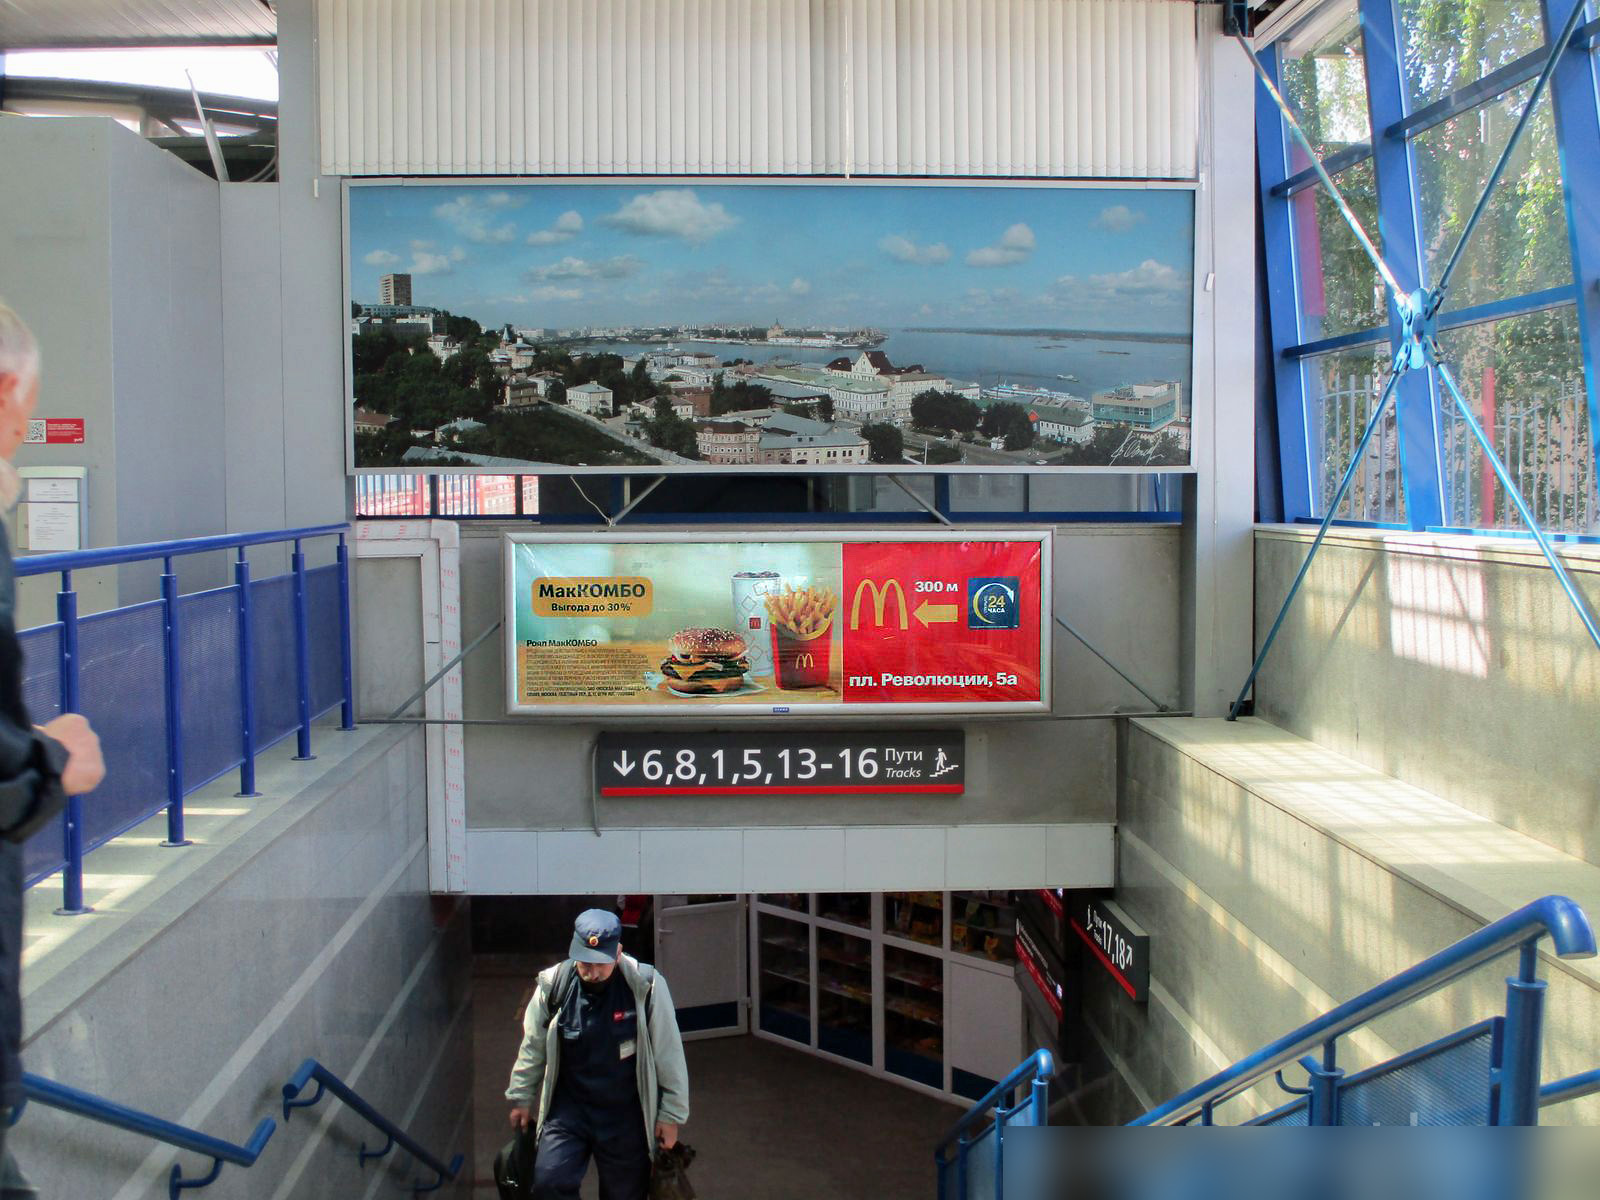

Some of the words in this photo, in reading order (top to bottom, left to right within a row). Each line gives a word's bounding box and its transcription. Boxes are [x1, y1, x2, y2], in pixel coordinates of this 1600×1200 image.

[539, 583, 646, 598] МакКОМБО
[915, 581, 944, 593] 300
[551, 603, 590, 613] Выгода
[592, 604, 606, 613] до
[988, 595, 1006, 608] 24
[526, 639, 547, 647] Роял
[548, 639, 598, 647] МакКОМБО
[849, 676, 877, 687] пл.
[881, 673, 993, 688] Революции,
[996, 673, 1018, 687] 5а
[885, 748, 923, 763] Пути
[885, 767, 921, 778] Tracks
[1102, 920, 1126, 970] 17,18
